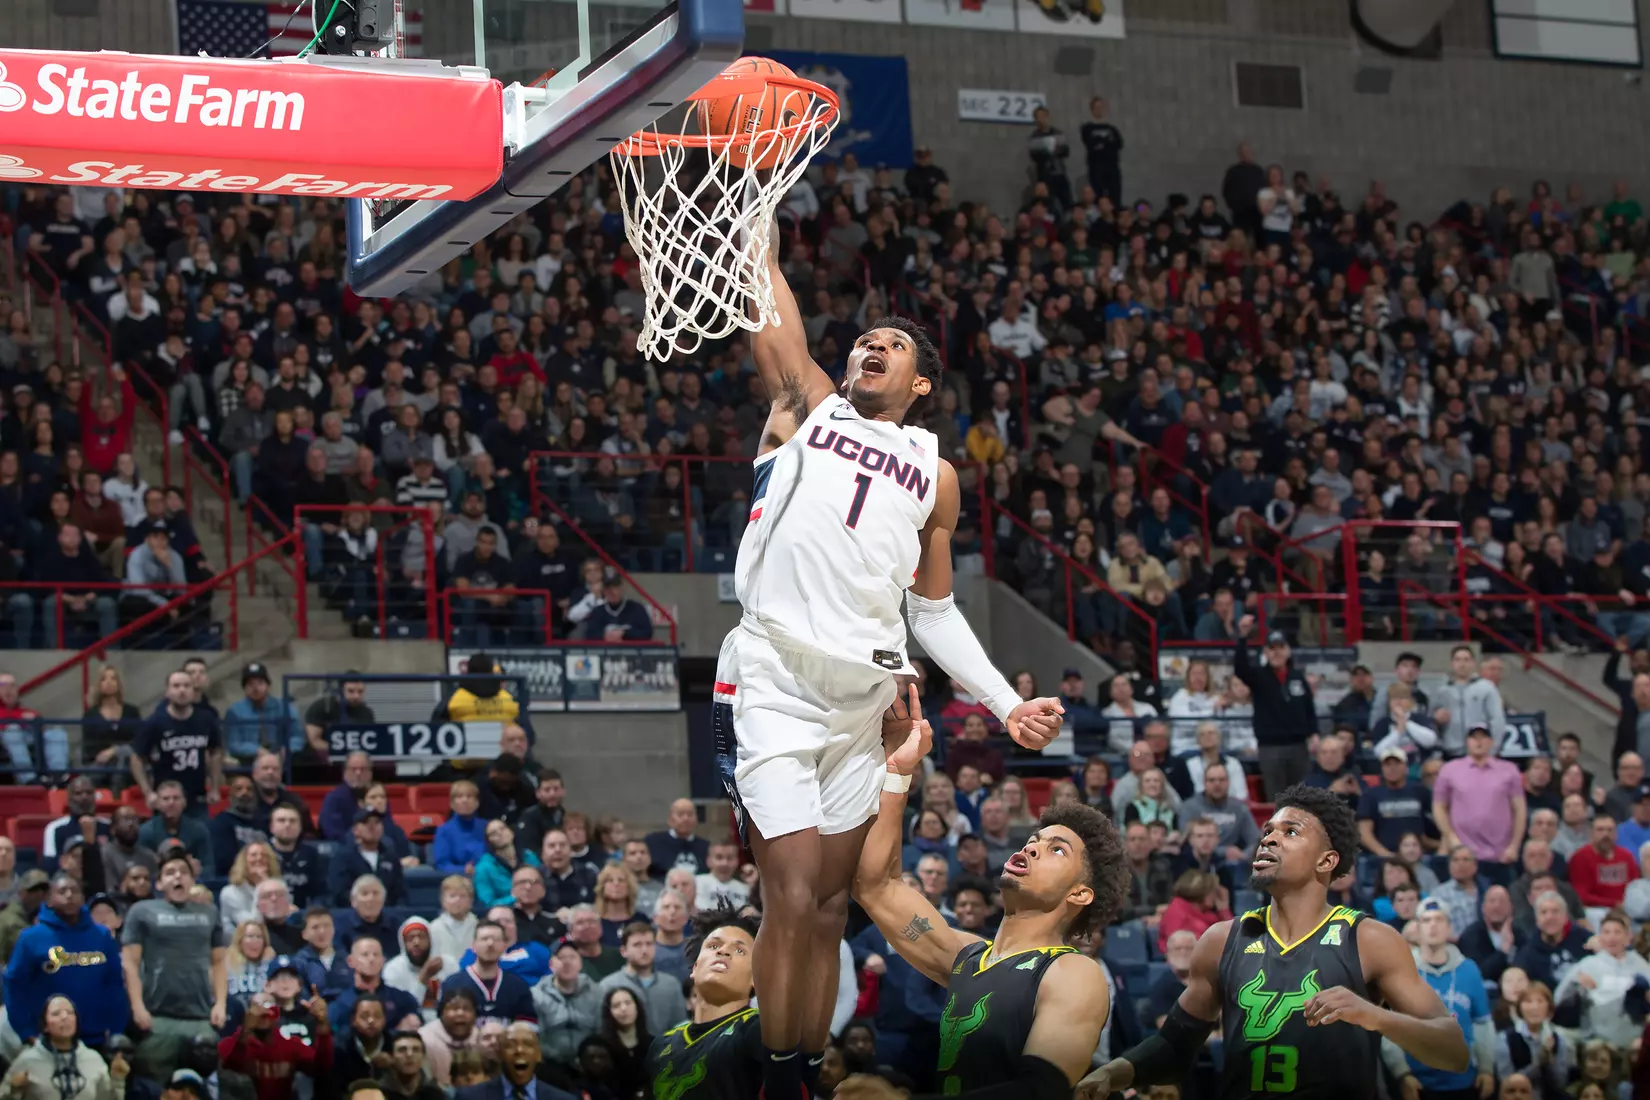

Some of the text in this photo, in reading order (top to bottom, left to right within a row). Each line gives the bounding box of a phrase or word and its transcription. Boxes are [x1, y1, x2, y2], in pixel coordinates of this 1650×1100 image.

[806, 425, 931, 503] UCONN
[845, 472, 873, 530] 1
[172, 748, 199, 771] 34
[331, 724, 464, 755] SEC 120
[1250, 1046, 1299, 1093] 13
